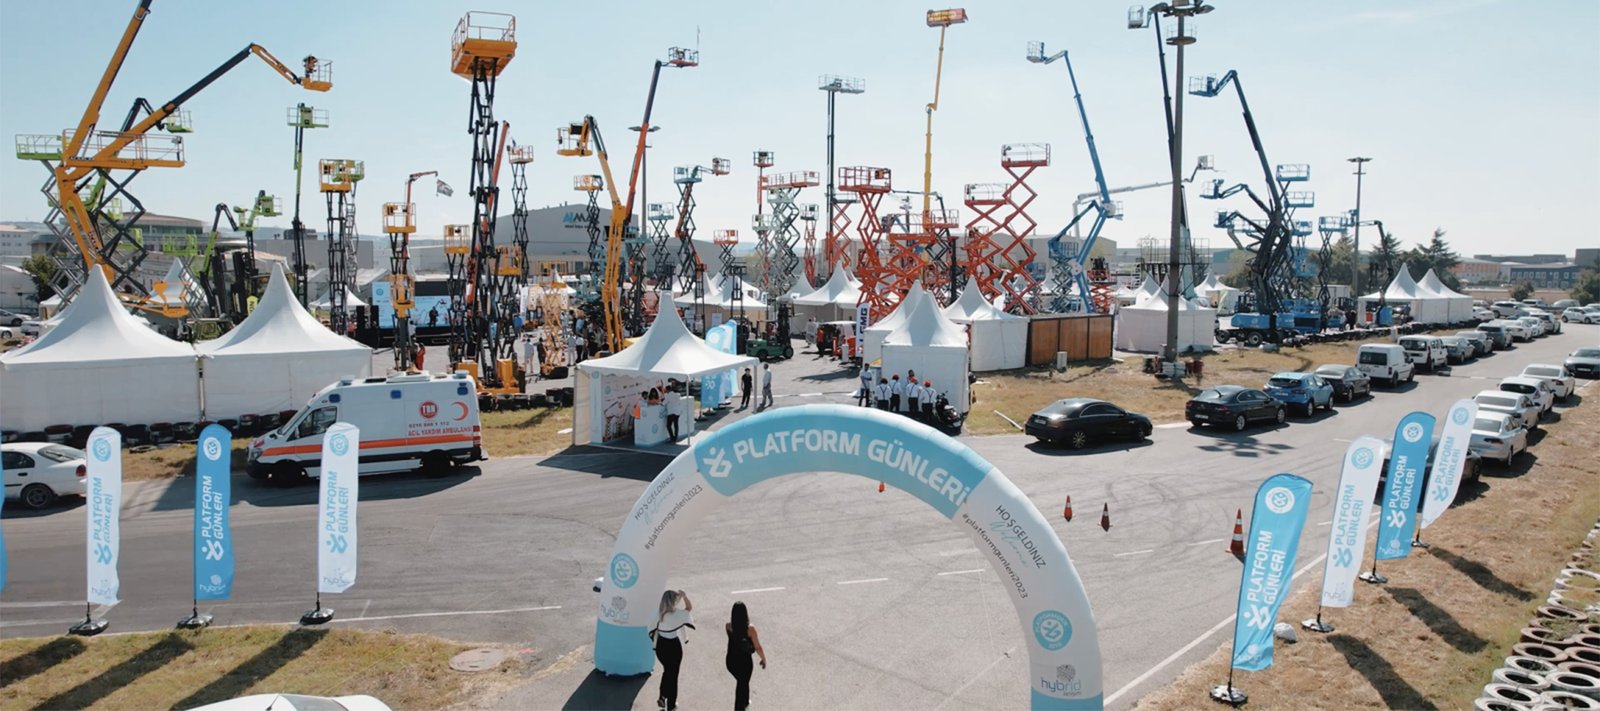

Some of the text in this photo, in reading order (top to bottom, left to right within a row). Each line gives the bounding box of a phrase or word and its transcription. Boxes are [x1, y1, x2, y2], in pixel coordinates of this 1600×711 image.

[733, 429, 972, 506] PLATFORM GÜNLERİ
[1389, 455, 1408, 509] PLATFORM
[1400, 468, 1417, 510] GÜNLERİ
[1437, 436, 1455, 486] PLATFORM
[92, 477, 103, 541] PLATFORM
[202, 475, 213, 538] PLATFORM
[213, 490, 224, 540] GÜNLERİ
[326, 471, 337, 532] PLATFORM
[1334, 484, 1355, 545] PLATFORM
[1346, 499, 1364, 546] GÜNLERİ
[1247, 530, 1272, 602] PLATFORM
[1263, 548, 1287, 606] GÜNLERİ
[1041, 677, 1082, 693] hybrid
